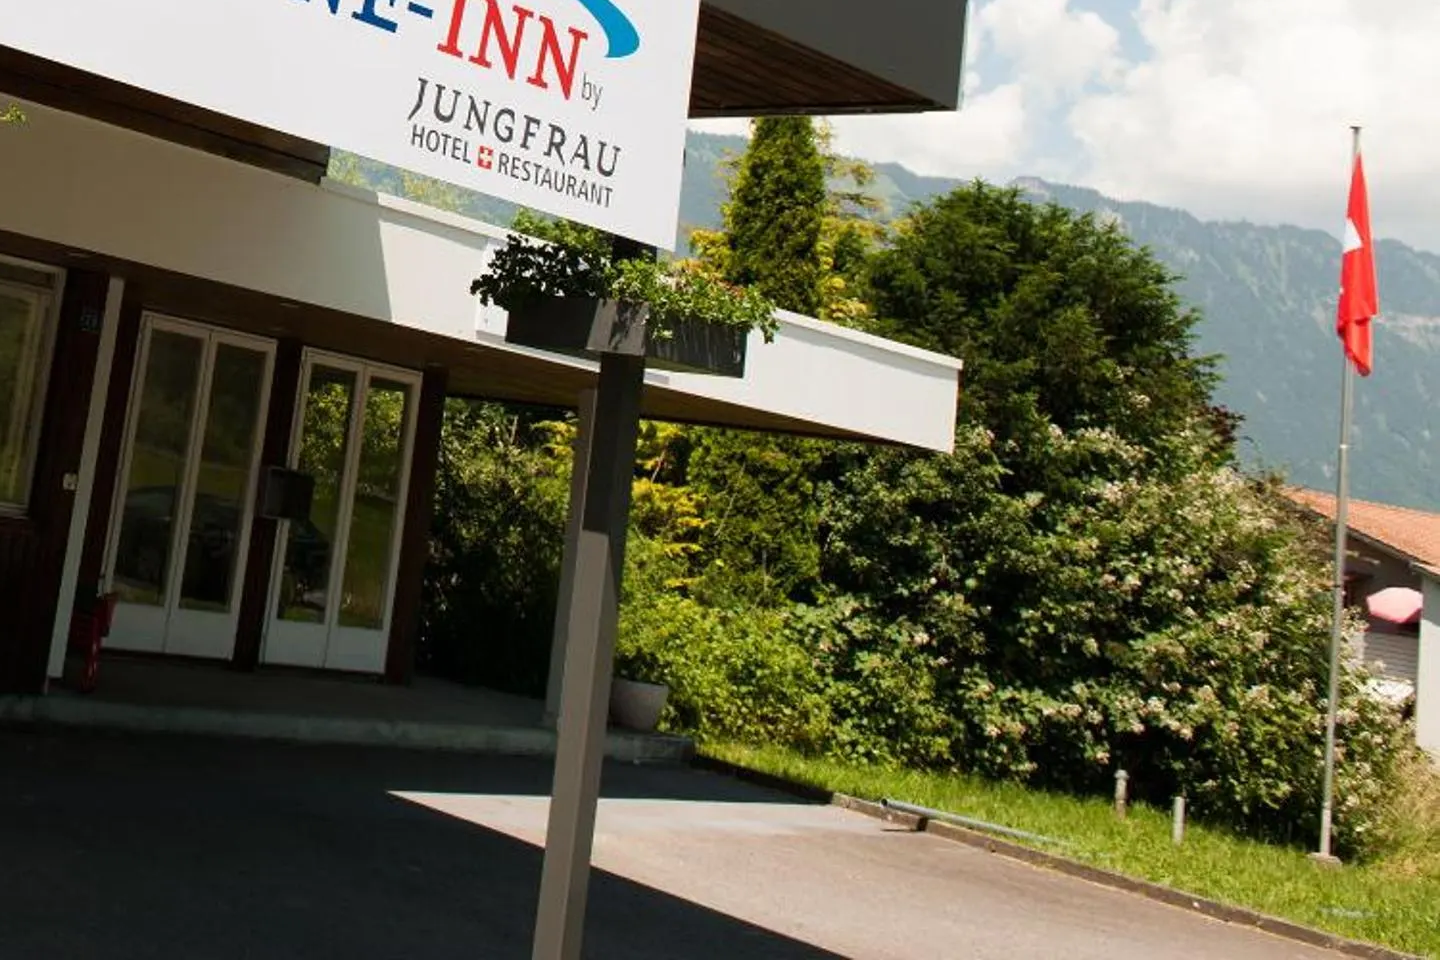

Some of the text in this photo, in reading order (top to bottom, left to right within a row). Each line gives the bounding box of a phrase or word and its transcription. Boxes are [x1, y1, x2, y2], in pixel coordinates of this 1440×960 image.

[407, 76, 622, 178] JUNGFRAU
[581, 73, 603, 111] by
[410, 123, 614, 208] HOTEL RESTAURANT
